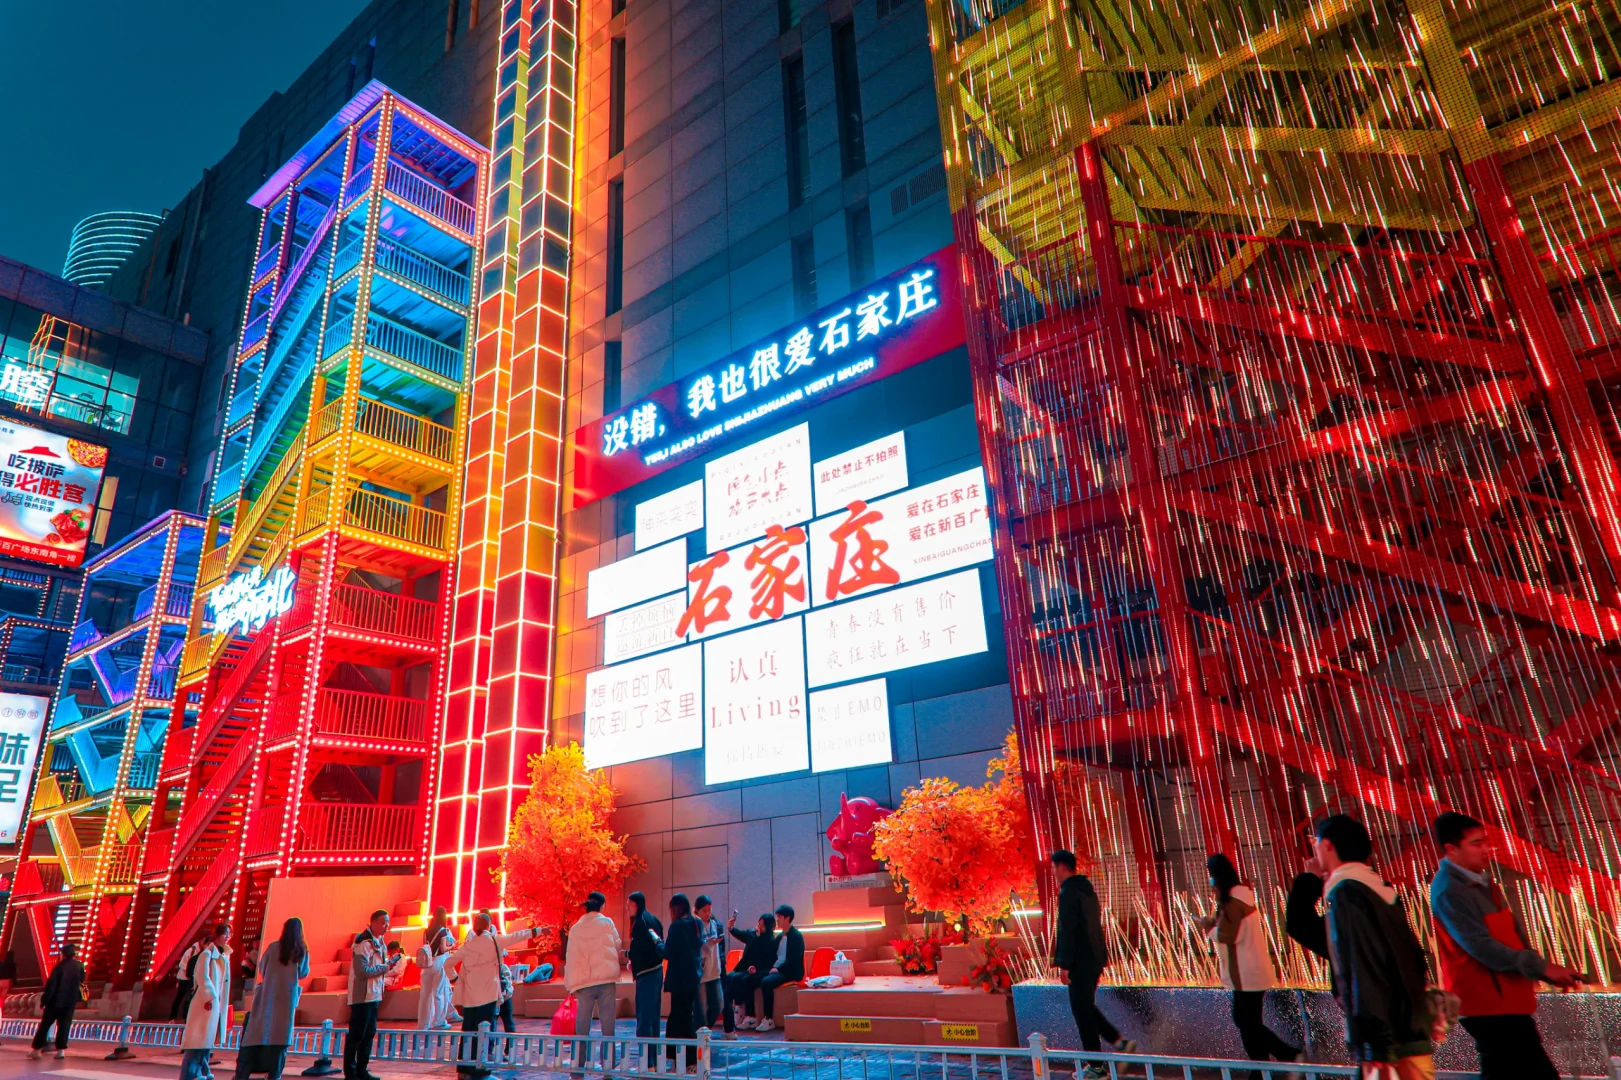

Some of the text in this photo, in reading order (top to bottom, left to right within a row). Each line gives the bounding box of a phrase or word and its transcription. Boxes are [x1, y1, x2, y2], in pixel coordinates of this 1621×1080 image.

[670, 436, 696, 456] ALSO
[696, 423, 723, 445] LOVE
[723, 388, 803, 432] SHIJIAZHUANG
[804, 373, 836, 396] VERY
[836, 356, 875, 381] MUCH
[7, 452, 67, 479] 吃披萨
[819, 444, 899, 484] 此处禁止不拍照
[0, 470, 87, 505] 得必胜客
[906, 483, 981, 520] 爱在石家庄
[640, 499, 698, 535] 神采奕奕
[675, 500, 901, 638] 石家庄
[826, 589, 957, 640] 青春没有售价
[826, 624, 958, 670] 疯狂就在当下
[729, 650, 779, 685] 认真
[590, 667, 674, 709] 想你的风
[589, 691, 697, 739] 吹到了这里
[711, 694, 802, 730] Living
[851, 1021, 870, 1030] 小心台阶
[953, 1028, 977, 1038] 小心台阶
